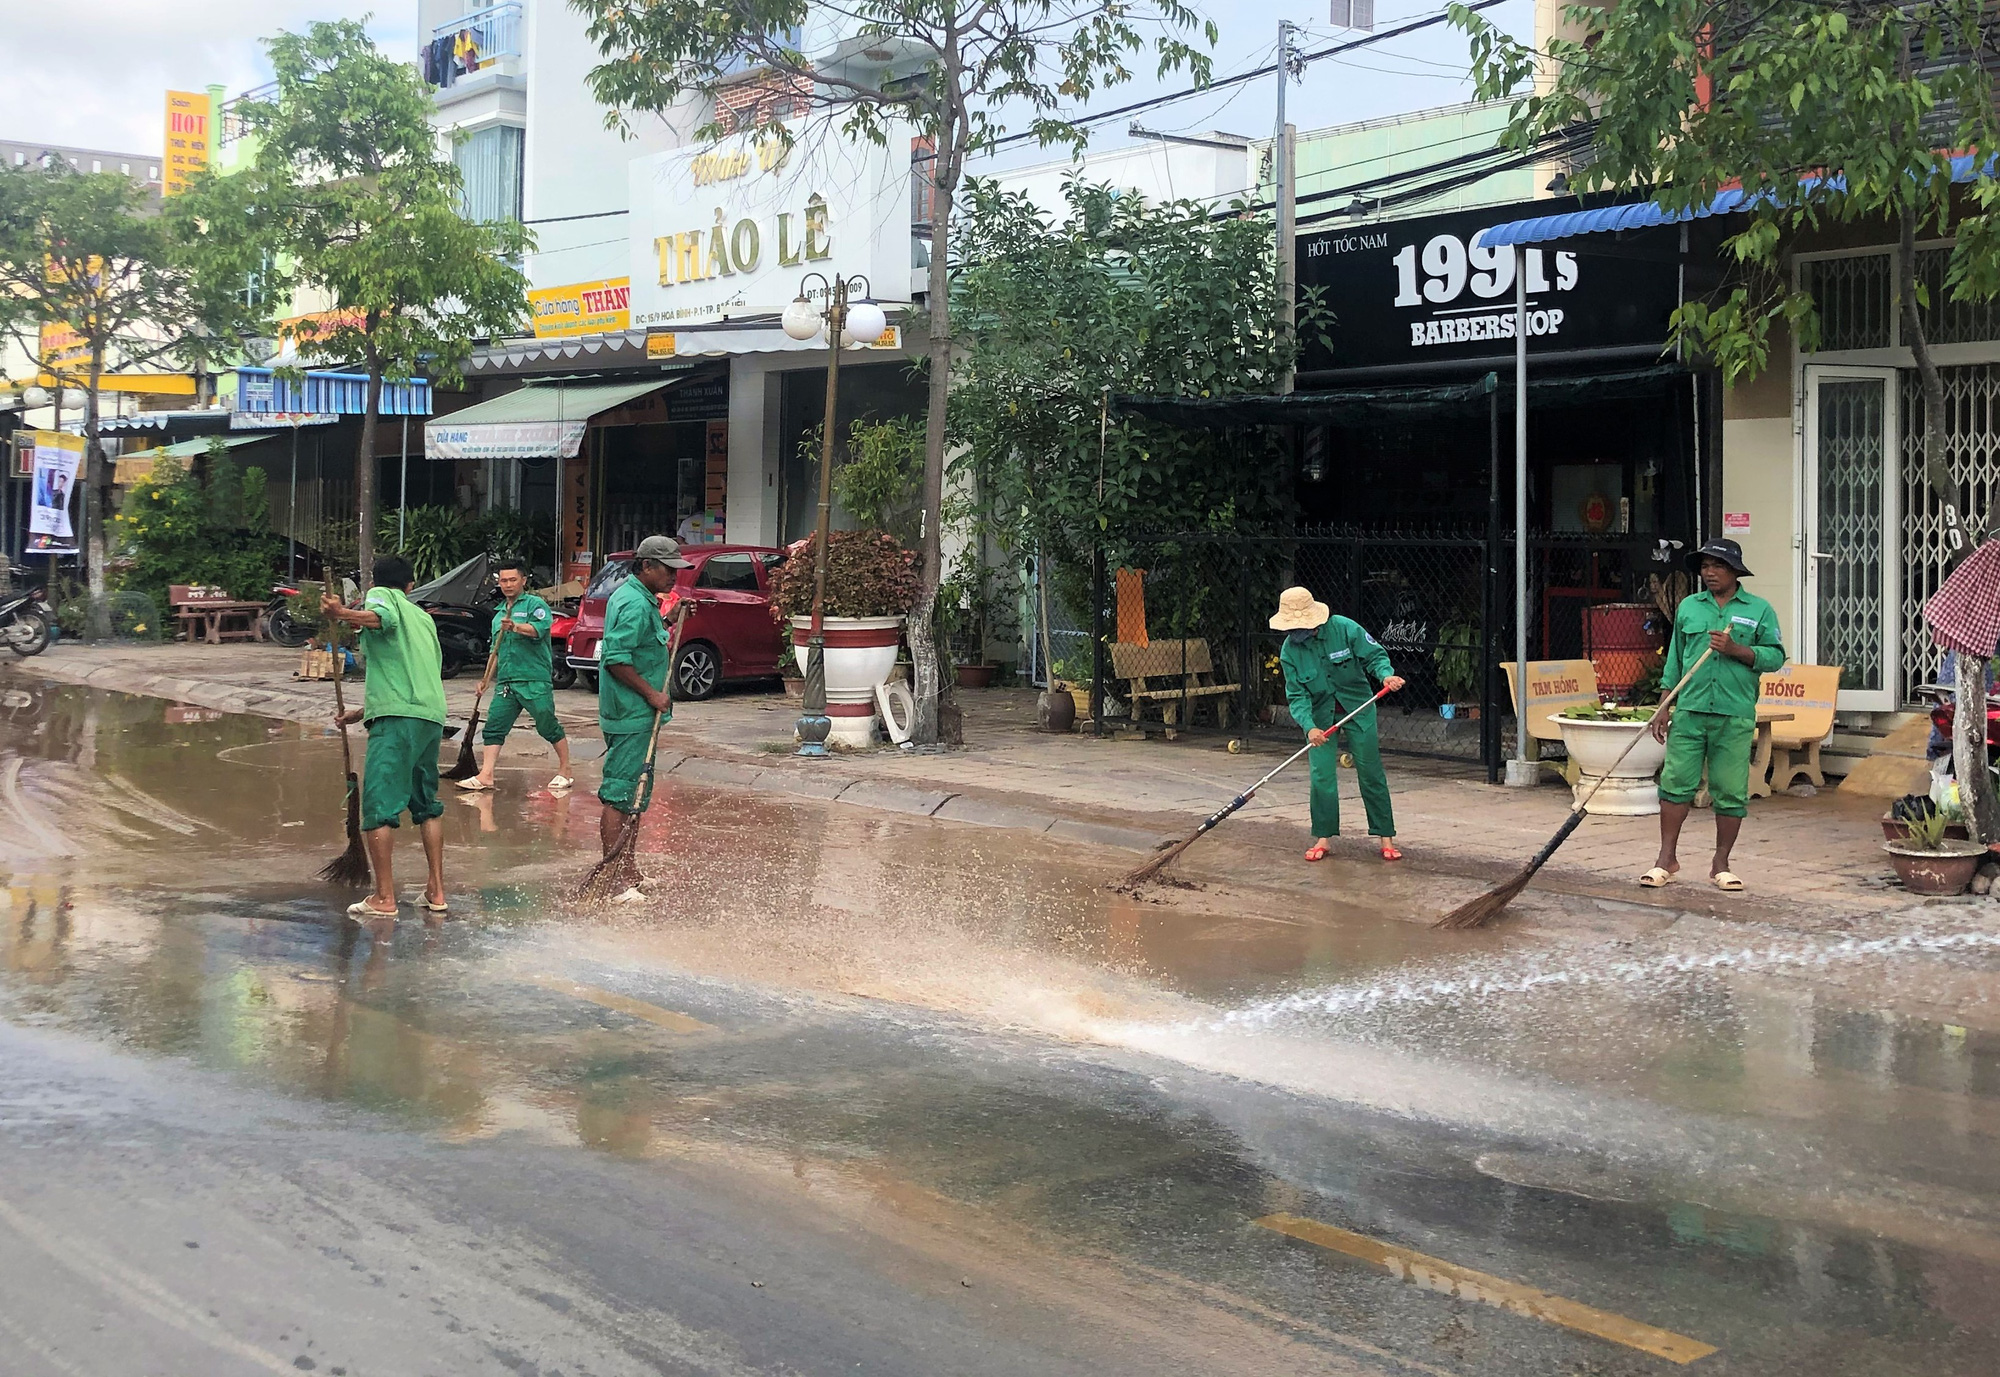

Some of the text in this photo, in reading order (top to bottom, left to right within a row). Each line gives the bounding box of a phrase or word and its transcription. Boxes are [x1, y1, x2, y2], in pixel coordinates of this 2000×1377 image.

[171, 112, 206, 135] HOT
[653, 191, 832, 287] THẢO LÊ
[1307, 232, 1388, 258] HỚT TÓC NAM
[535, 283, 630, 316] Cửa hàng THÀN
[1410, 308, 1565, 347] BARBERSHOP
[449, 429, 469, 444] HÀNG
